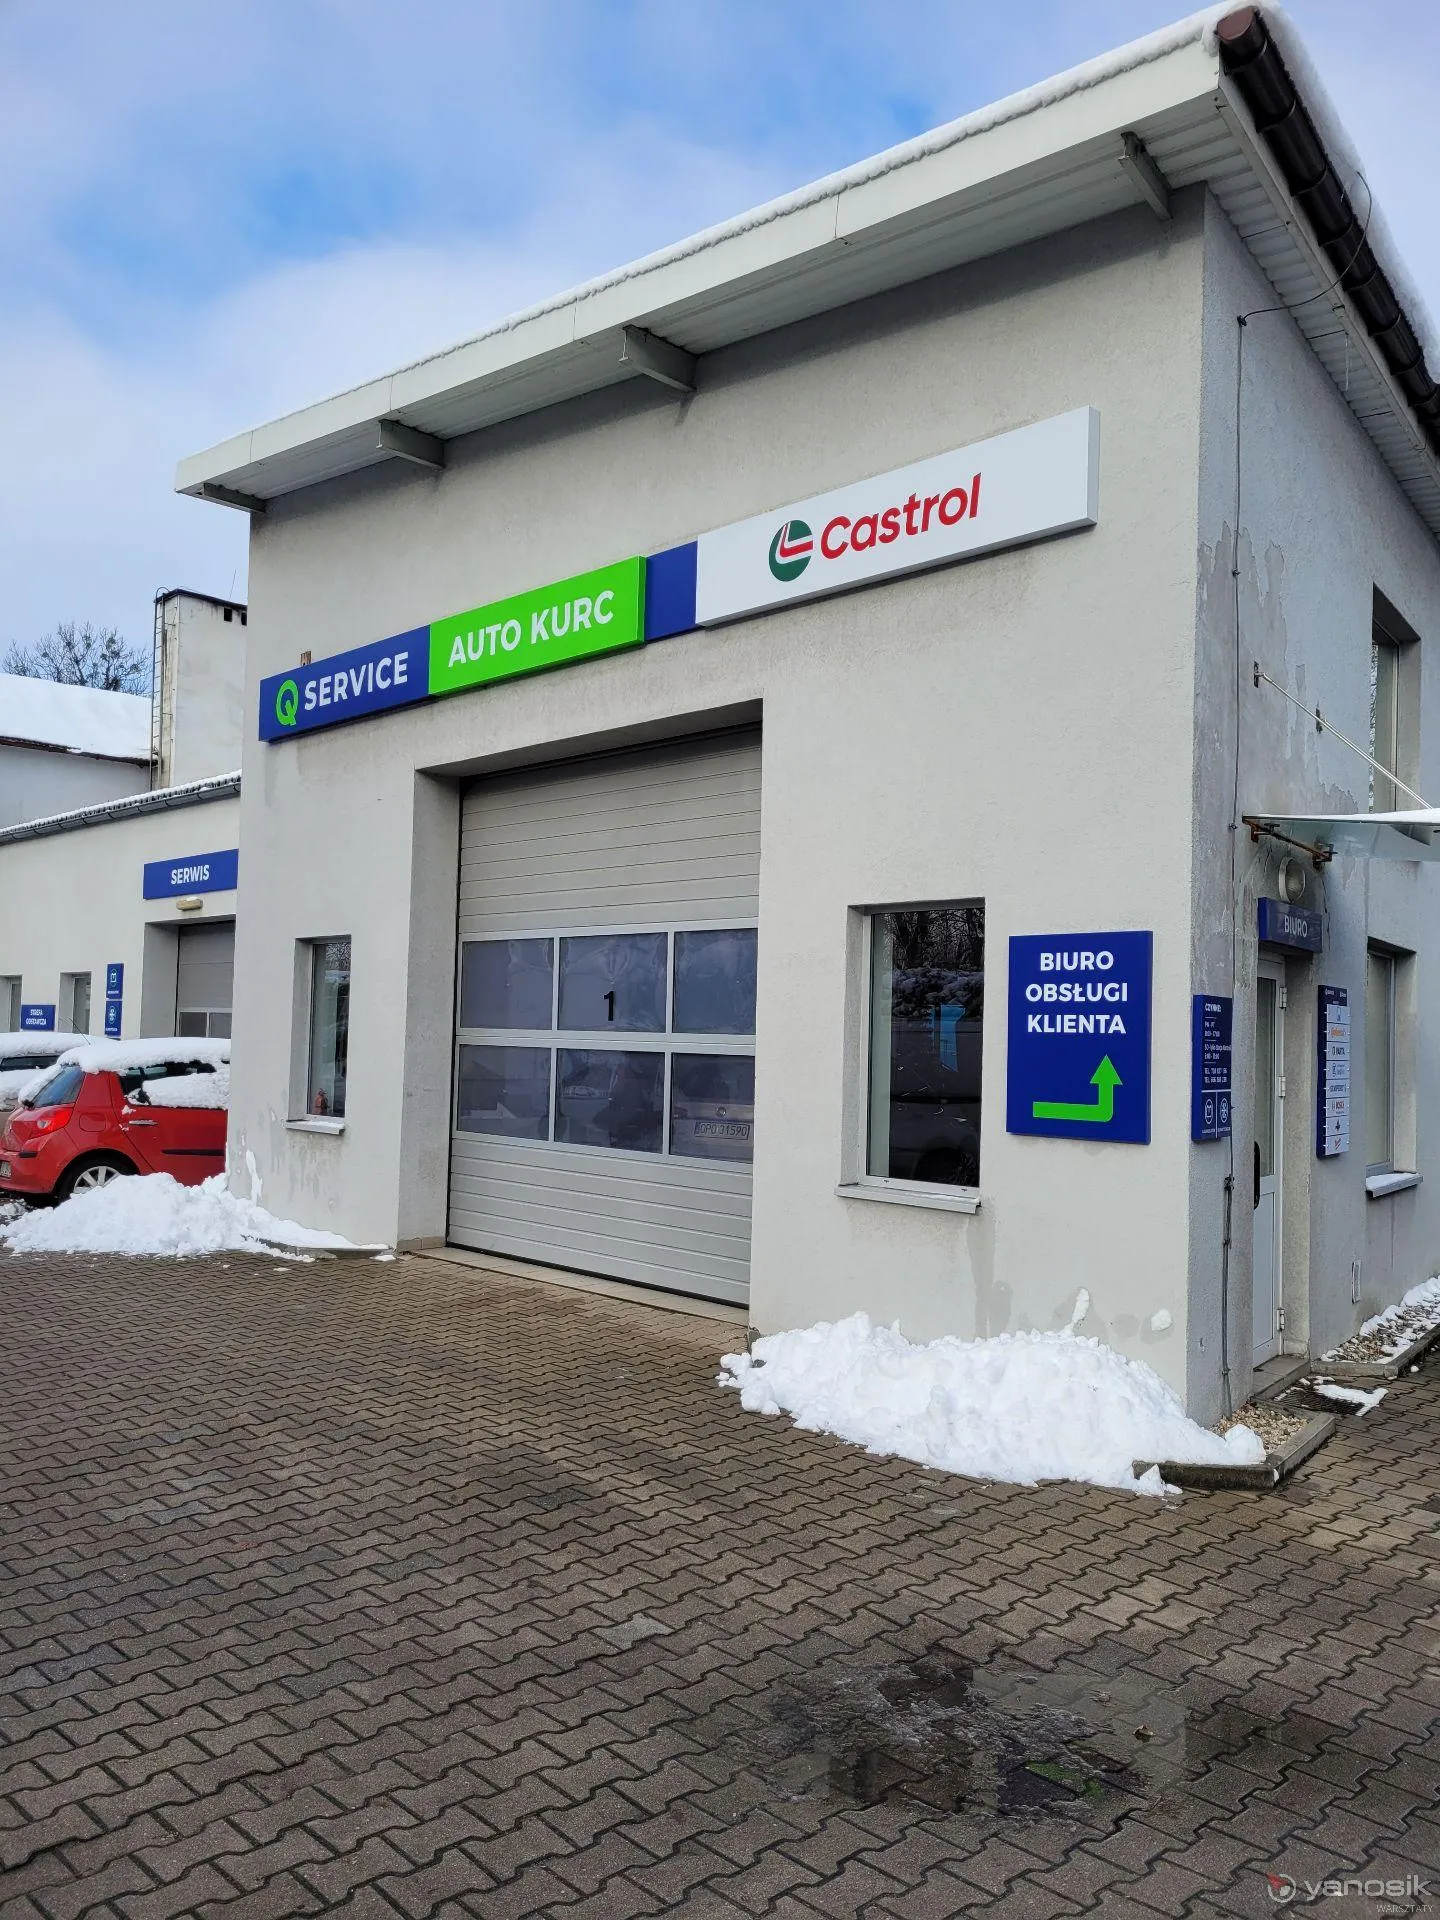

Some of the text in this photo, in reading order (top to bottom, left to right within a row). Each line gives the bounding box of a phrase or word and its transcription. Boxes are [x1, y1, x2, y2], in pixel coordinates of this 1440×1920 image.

[821, 472, 982, 560] Castrol
[448, 590, 615, 668] AUTO KURC
[275, 651, 409, 726] Q SERVICE
[171, 865, 210, 885] SERWIS
[1283, 915, 1309, 938] BIURO
[1040, 950, 1114, 971] BIURO
[1025, 982, 1128, 1002] OBSŁUGI
[603, 991, 616, 1022] 1
[1027, 1014, 1126, 1034] KLIENTA
